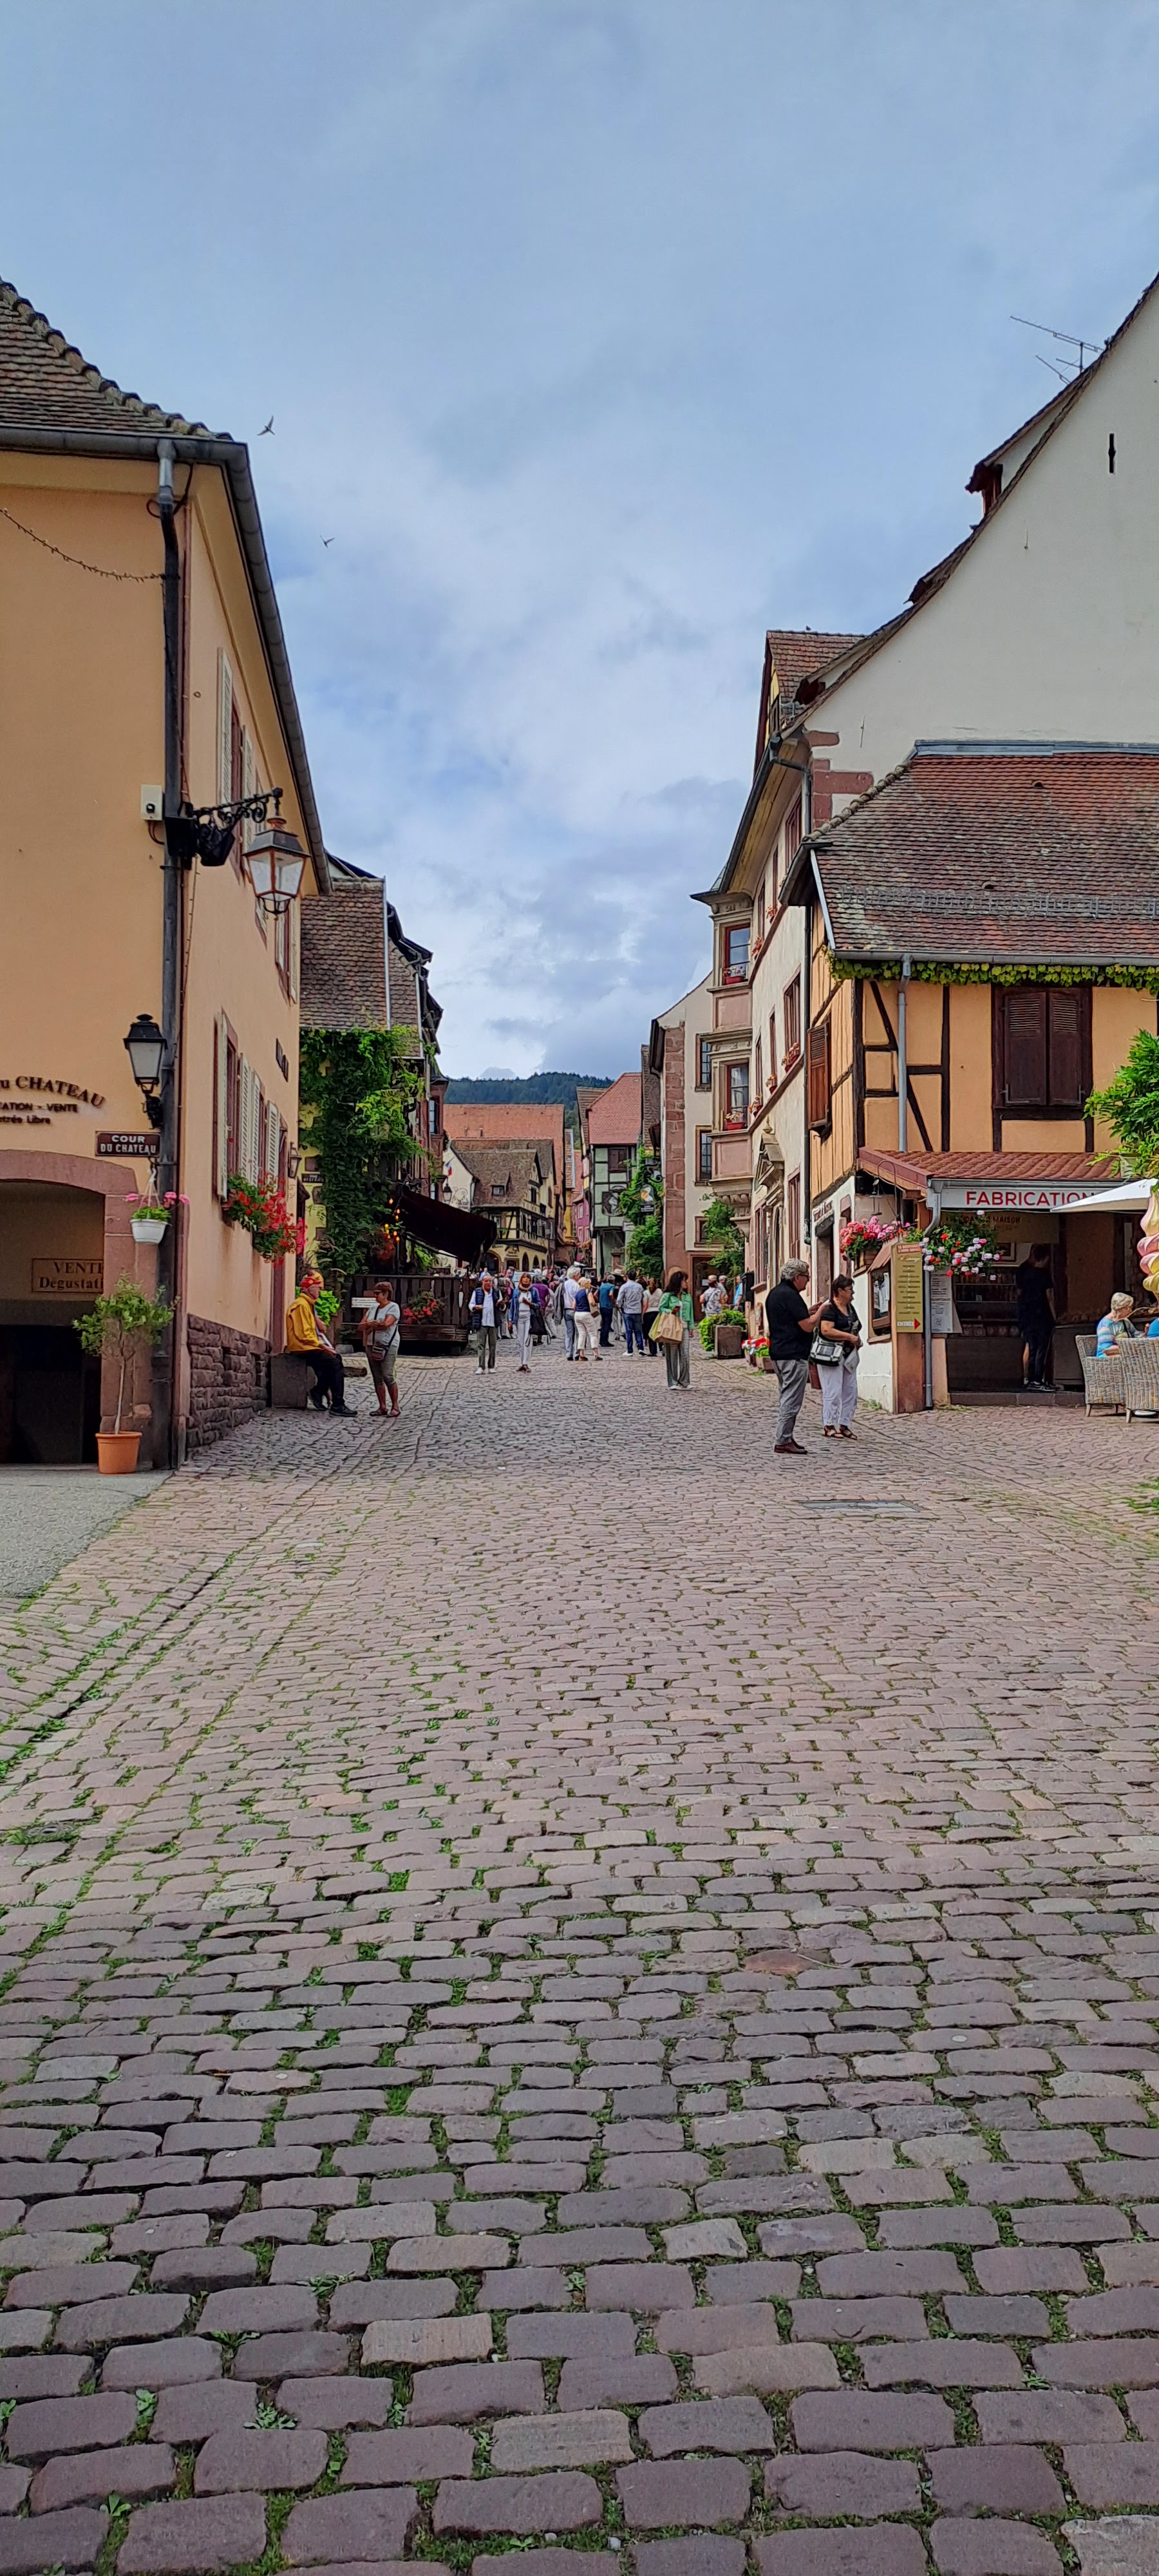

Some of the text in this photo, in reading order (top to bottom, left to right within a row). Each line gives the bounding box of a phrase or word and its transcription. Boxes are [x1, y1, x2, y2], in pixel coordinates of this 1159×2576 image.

[0, 1075, 106, 1108] u CHATEAU
[0, 1102, 33, 1112] ATION
[46, 1103, 79, 1113] VENTE
[27, 1115, 51, 1124] Libre
[111, 1135, 146, 1143] COUR
[100, 1143, 156, 1154] DU CHATEAU
